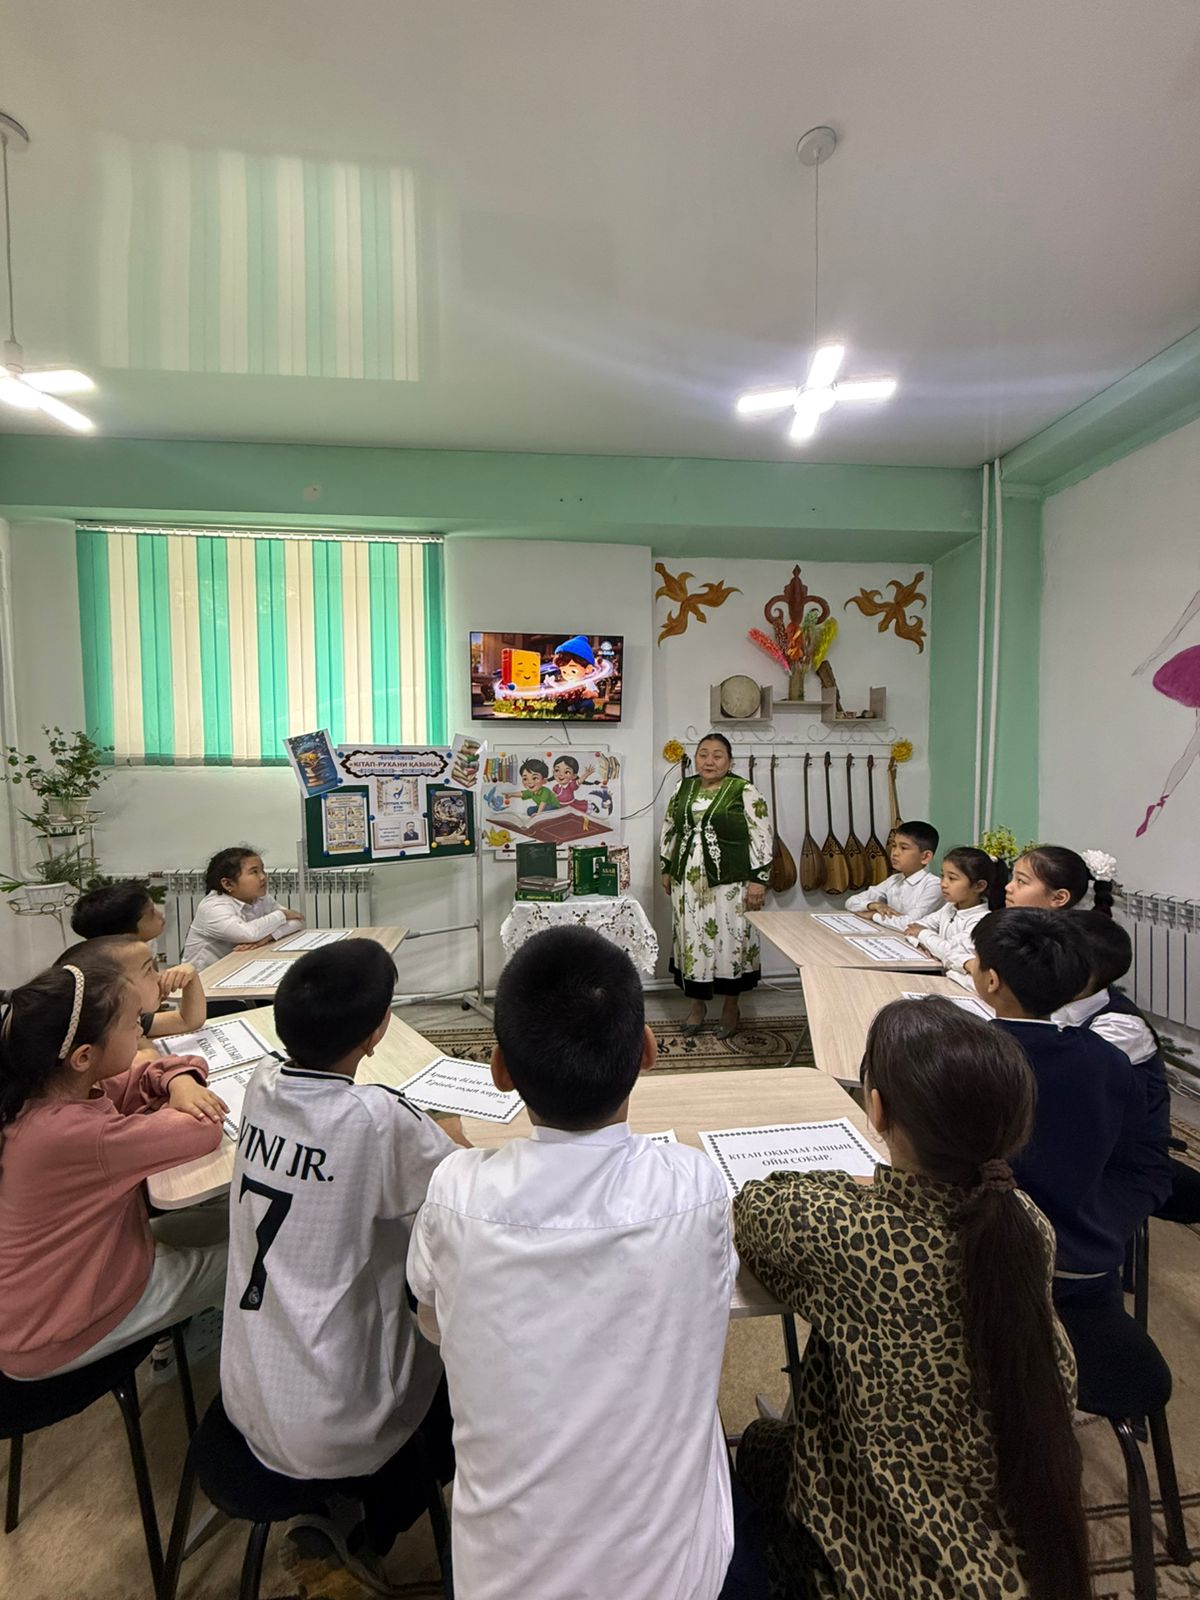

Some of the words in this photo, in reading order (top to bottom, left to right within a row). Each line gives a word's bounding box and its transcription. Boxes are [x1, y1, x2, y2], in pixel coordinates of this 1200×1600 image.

[238, 1116, 286, 1171] VINI
[286, 1142, 335, 1182] JR.
[239, 1173, 294, 1311] 7
